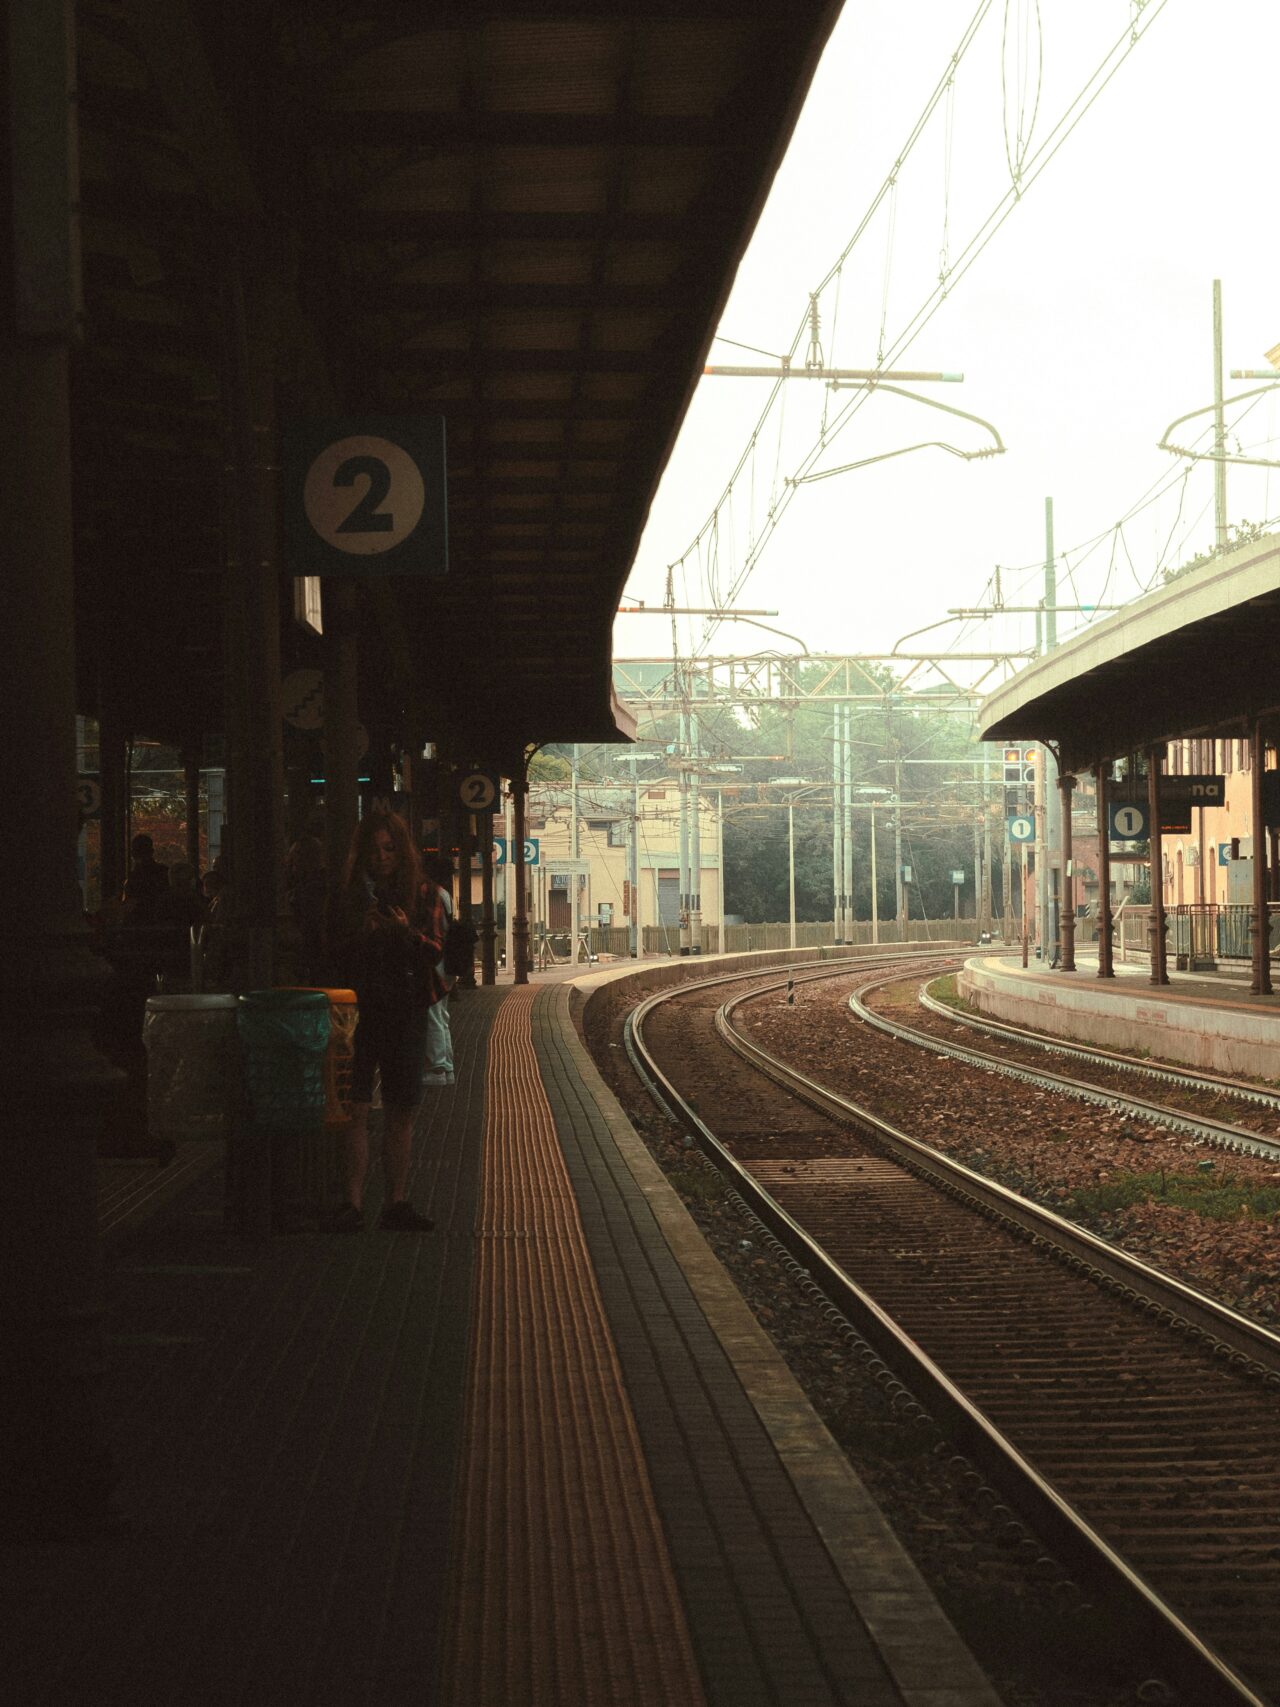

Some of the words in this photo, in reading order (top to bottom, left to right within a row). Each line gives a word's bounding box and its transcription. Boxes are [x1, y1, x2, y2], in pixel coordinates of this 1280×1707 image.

[333, 455, 394, 533] 2
[468, 781, 486, 803] 2
[1018, 823, 1024, 835] 1
[1124, 812, 1133, 831] 1
[523, 845, 531, 858] 2
